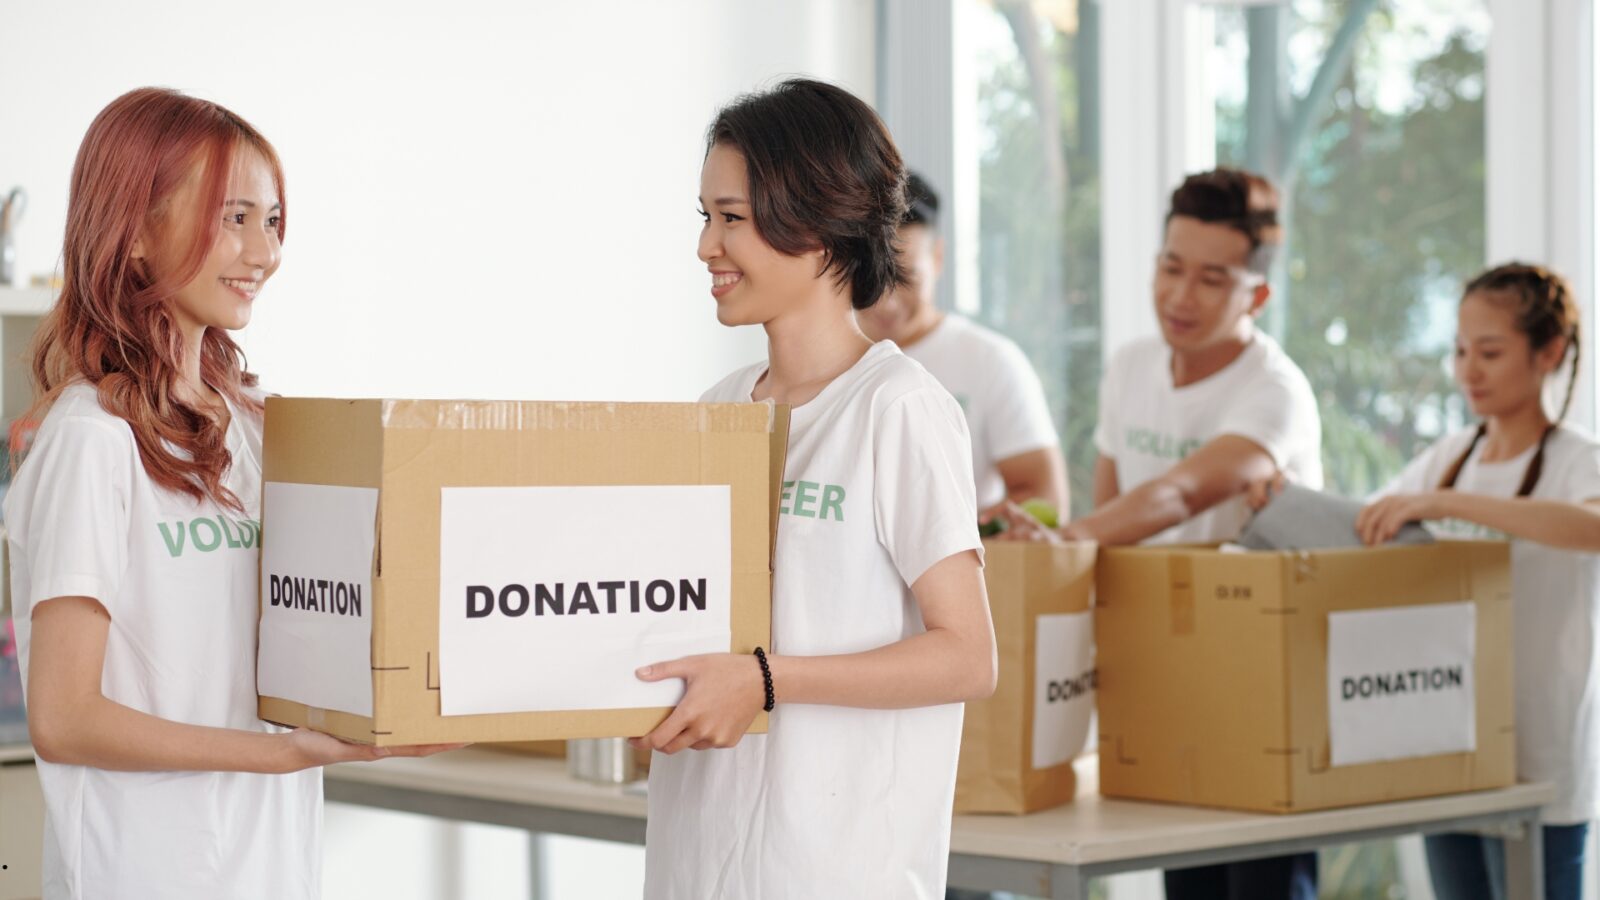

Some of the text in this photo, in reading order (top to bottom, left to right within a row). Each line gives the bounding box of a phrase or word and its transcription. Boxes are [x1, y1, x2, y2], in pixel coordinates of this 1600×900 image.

[270, 574, 362, 617] DONATION
[466, 578, 707, 618] DONATION
[1342, 665, 1462, 700] DONATION
